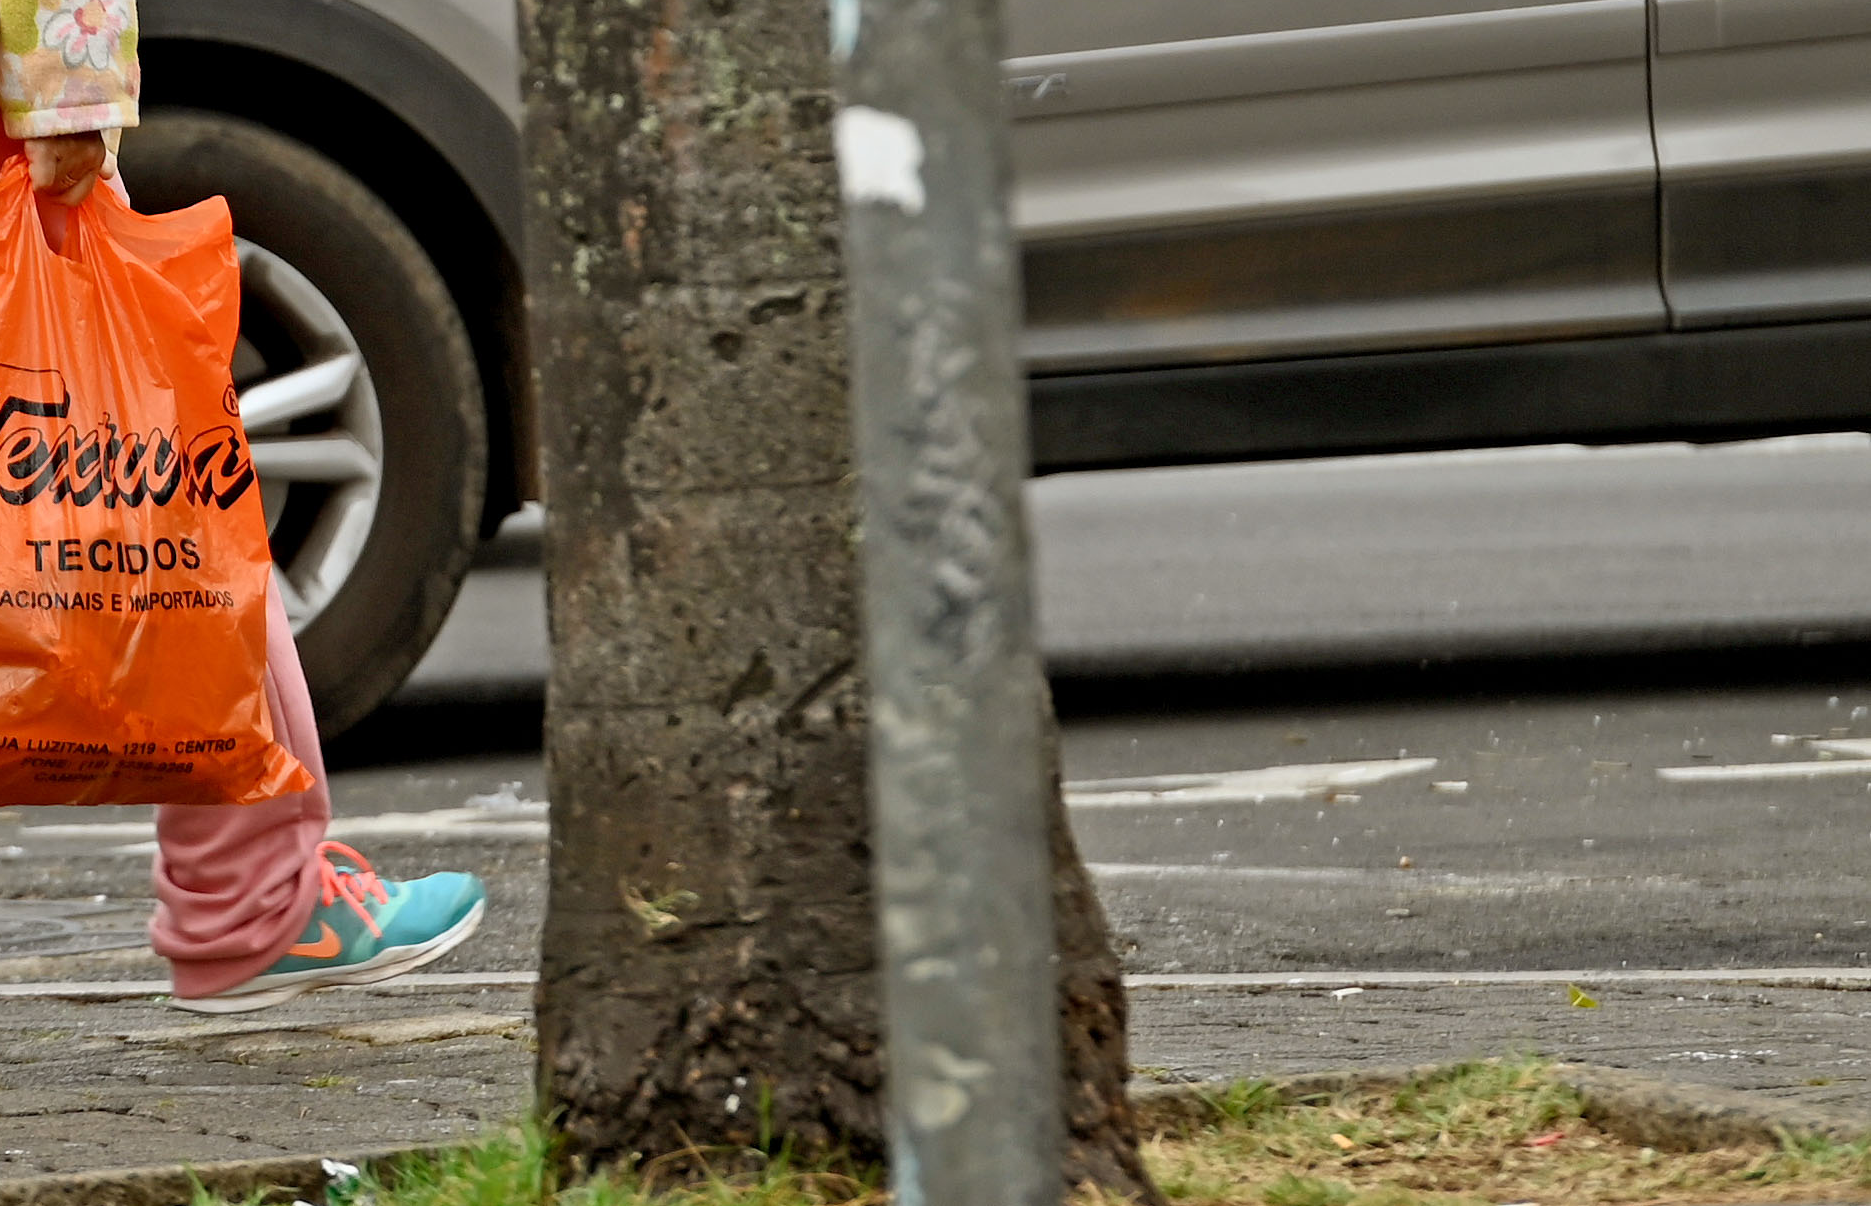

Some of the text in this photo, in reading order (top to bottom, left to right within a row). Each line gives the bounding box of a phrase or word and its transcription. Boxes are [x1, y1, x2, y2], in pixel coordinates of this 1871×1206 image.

[25, 537, 201, 575] TECIDOS
[111, 593, 123, 612] E
[121, 742, 156, 756] 1219
[174, 738, 236, 755] CENTRO
